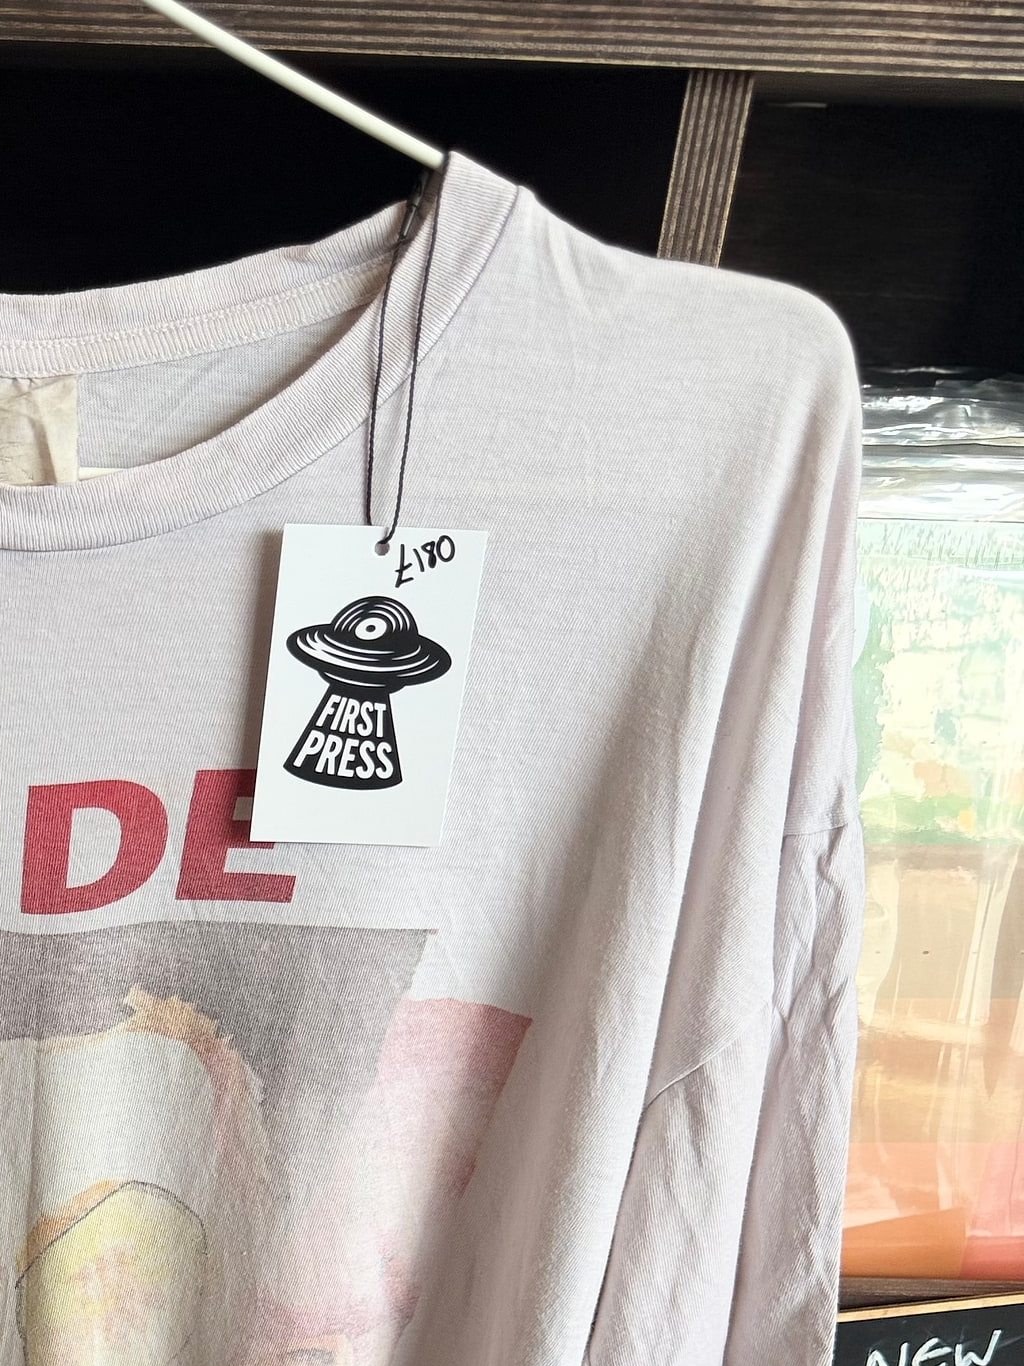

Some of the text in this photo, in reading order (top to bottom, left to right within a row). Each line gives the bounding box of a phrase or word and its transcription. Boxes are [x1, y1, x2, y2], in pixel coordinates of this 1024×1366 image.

[395, 535, 455, 588] £180
[316, 694, 387, 738] FIRST
[293, 730, 394, 779] PRESS
